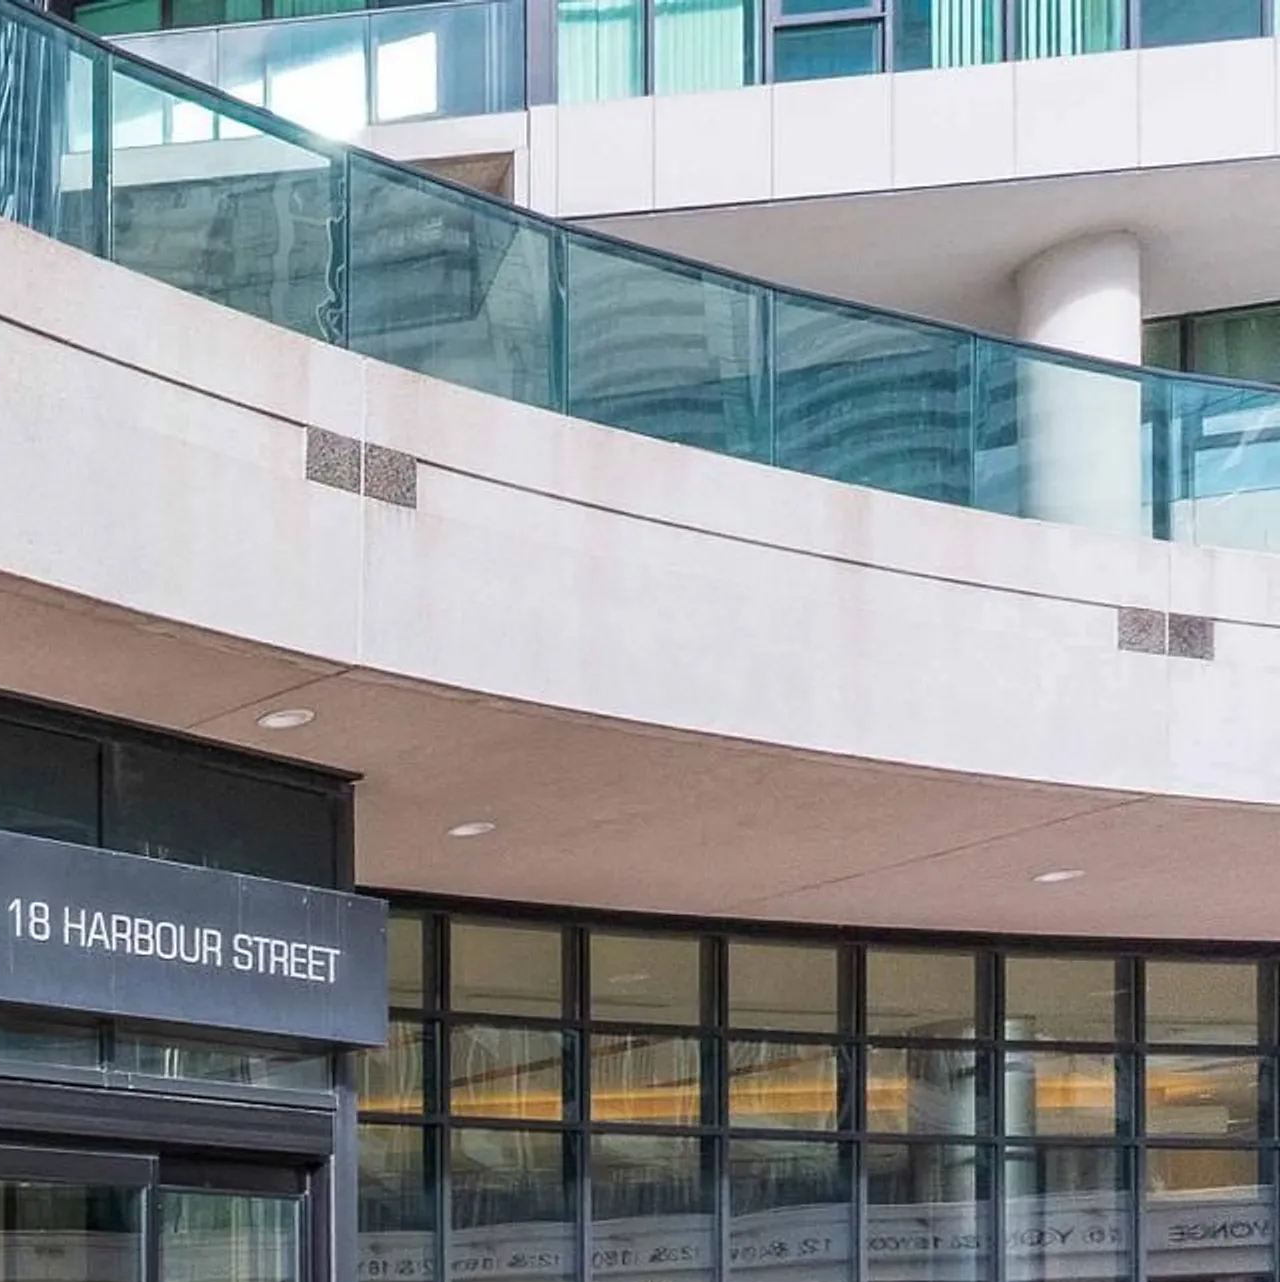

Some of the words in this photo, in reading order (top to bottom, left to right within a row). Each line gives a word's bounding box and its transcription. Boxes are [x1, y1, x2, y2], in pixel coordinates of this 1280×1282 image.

[7, 897, 51, 942] 18
[62, 905, 223, 968] HARBOUR
[232, 933, 341, 984] STREET
